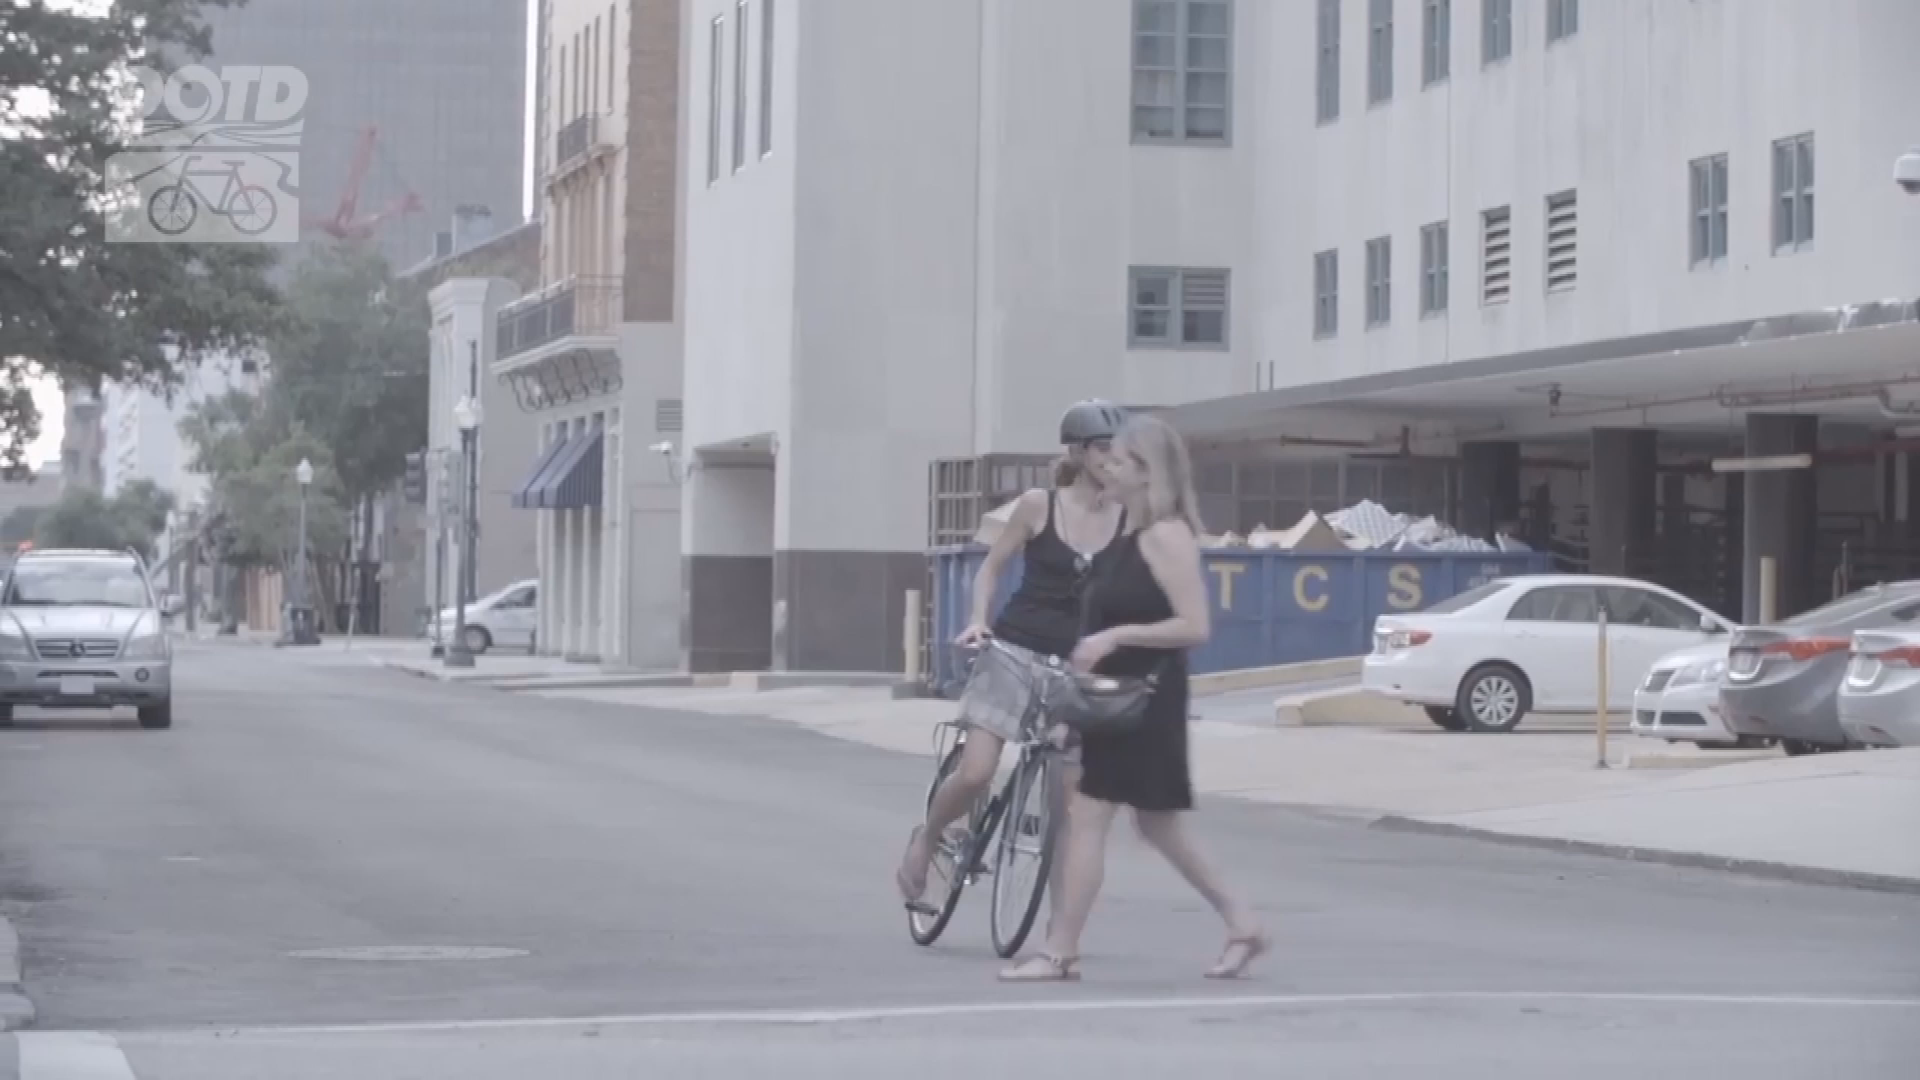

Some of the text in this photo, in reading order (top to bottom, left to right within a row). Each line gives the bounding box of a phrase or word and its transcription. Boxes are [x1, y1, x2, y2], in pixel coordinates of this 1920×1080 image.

[1208, 562, 1421, 612] T C S
